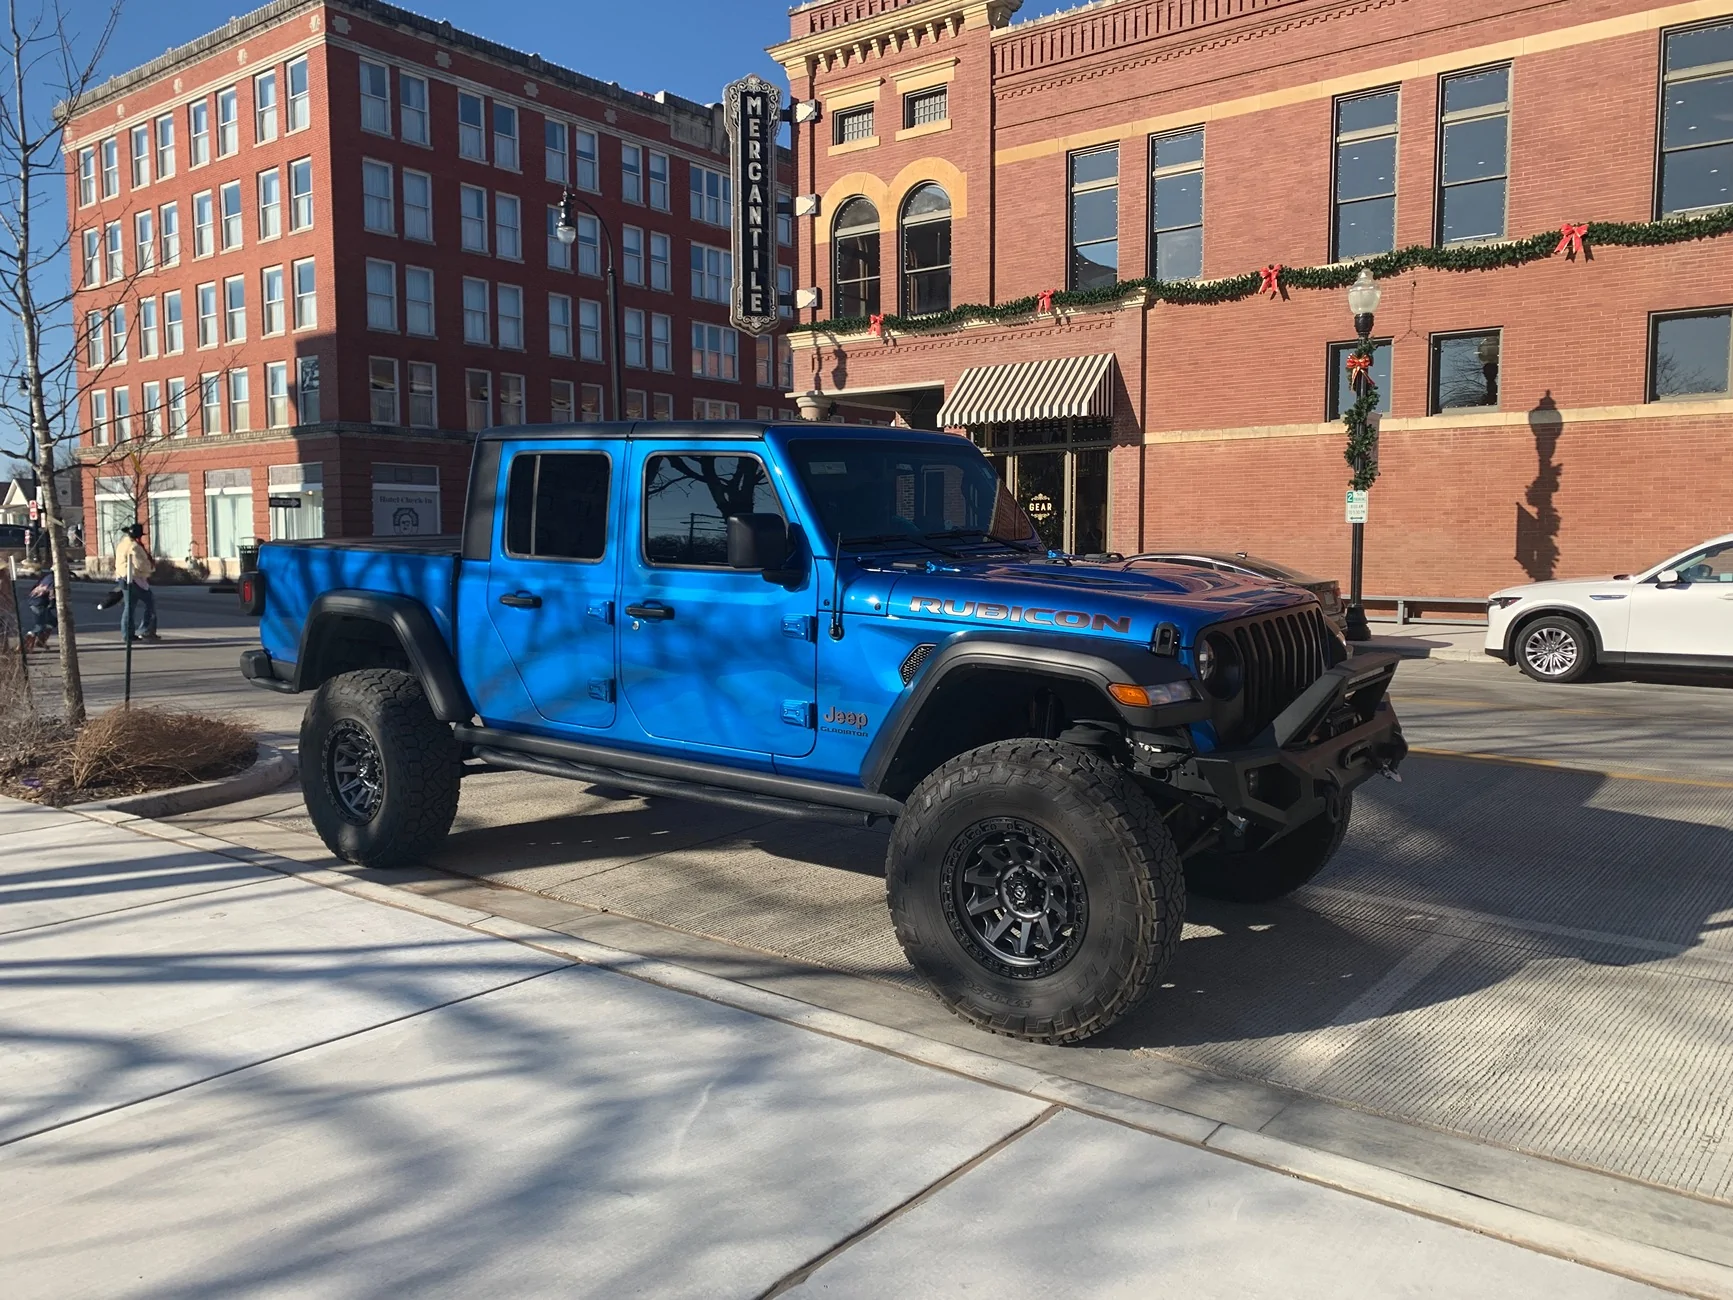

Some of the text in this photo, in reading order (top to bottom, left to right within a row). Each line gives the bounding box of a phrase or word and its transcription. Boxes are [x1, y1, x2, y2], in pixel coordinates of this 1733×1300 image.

[746, 96, 762, 312] MERCANTILE
[1029, 502, 1052, 511] GEAR
[909, 596, 1132, 633] RUBICON
[824, 706, 868, 729] Jeep
[820, 726, 869, 737] GLADIATOR
